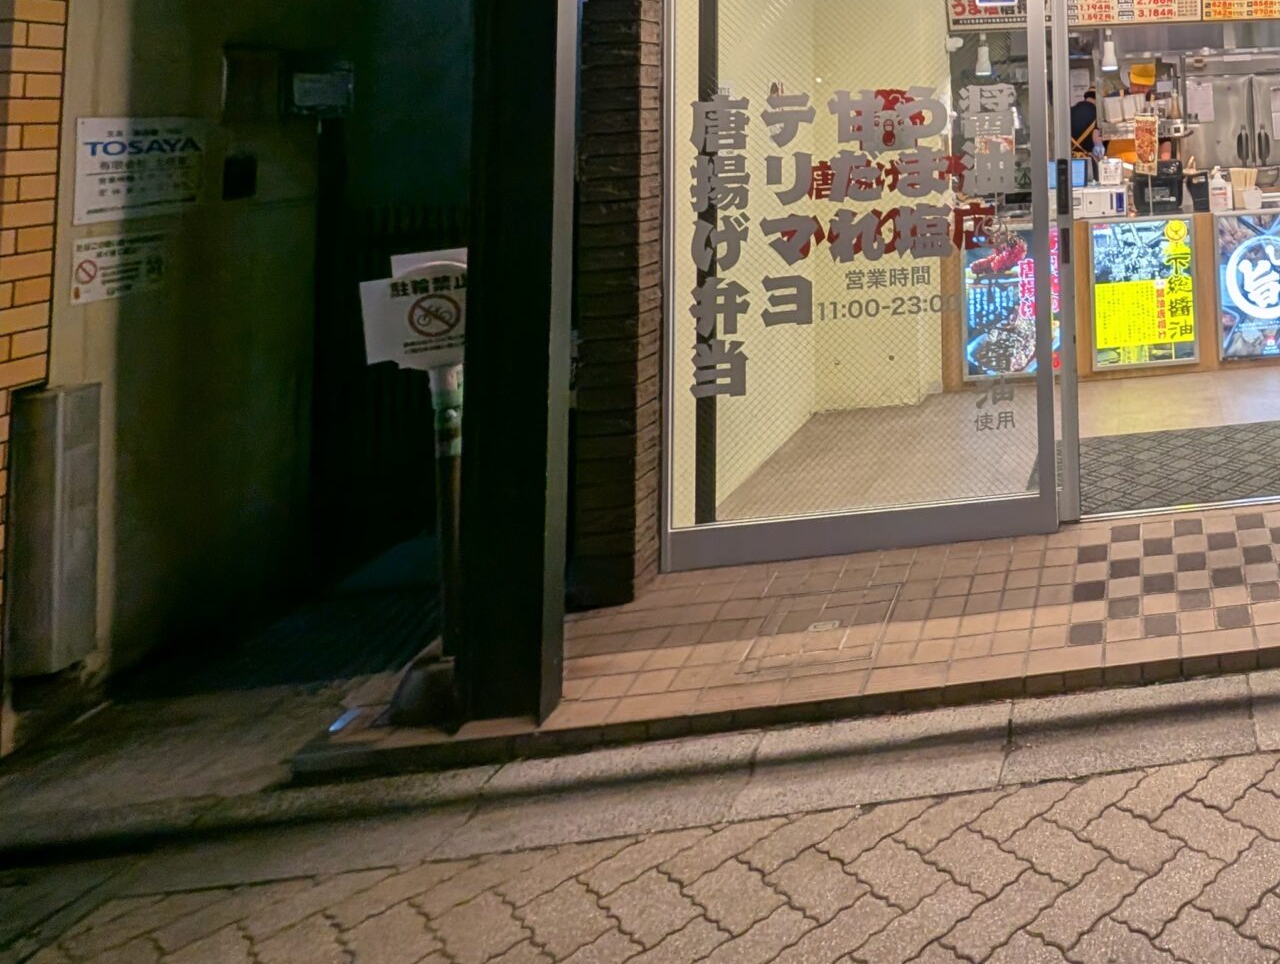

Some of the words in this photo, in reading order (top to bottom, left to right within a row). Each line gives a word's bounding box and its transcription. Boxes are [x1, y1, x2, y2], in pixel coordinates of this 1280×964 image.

[84, 137, 201, 156] TOSAYA
[759, 91, 817, 328] テリマヨ
[828, 89, 885, 264] 甘だれ
[896, 86, 955, 258] うま塩
[689, 94, 750, 398] 唐揚げ弁当
[844, 265, 932, 291] 営業時間
